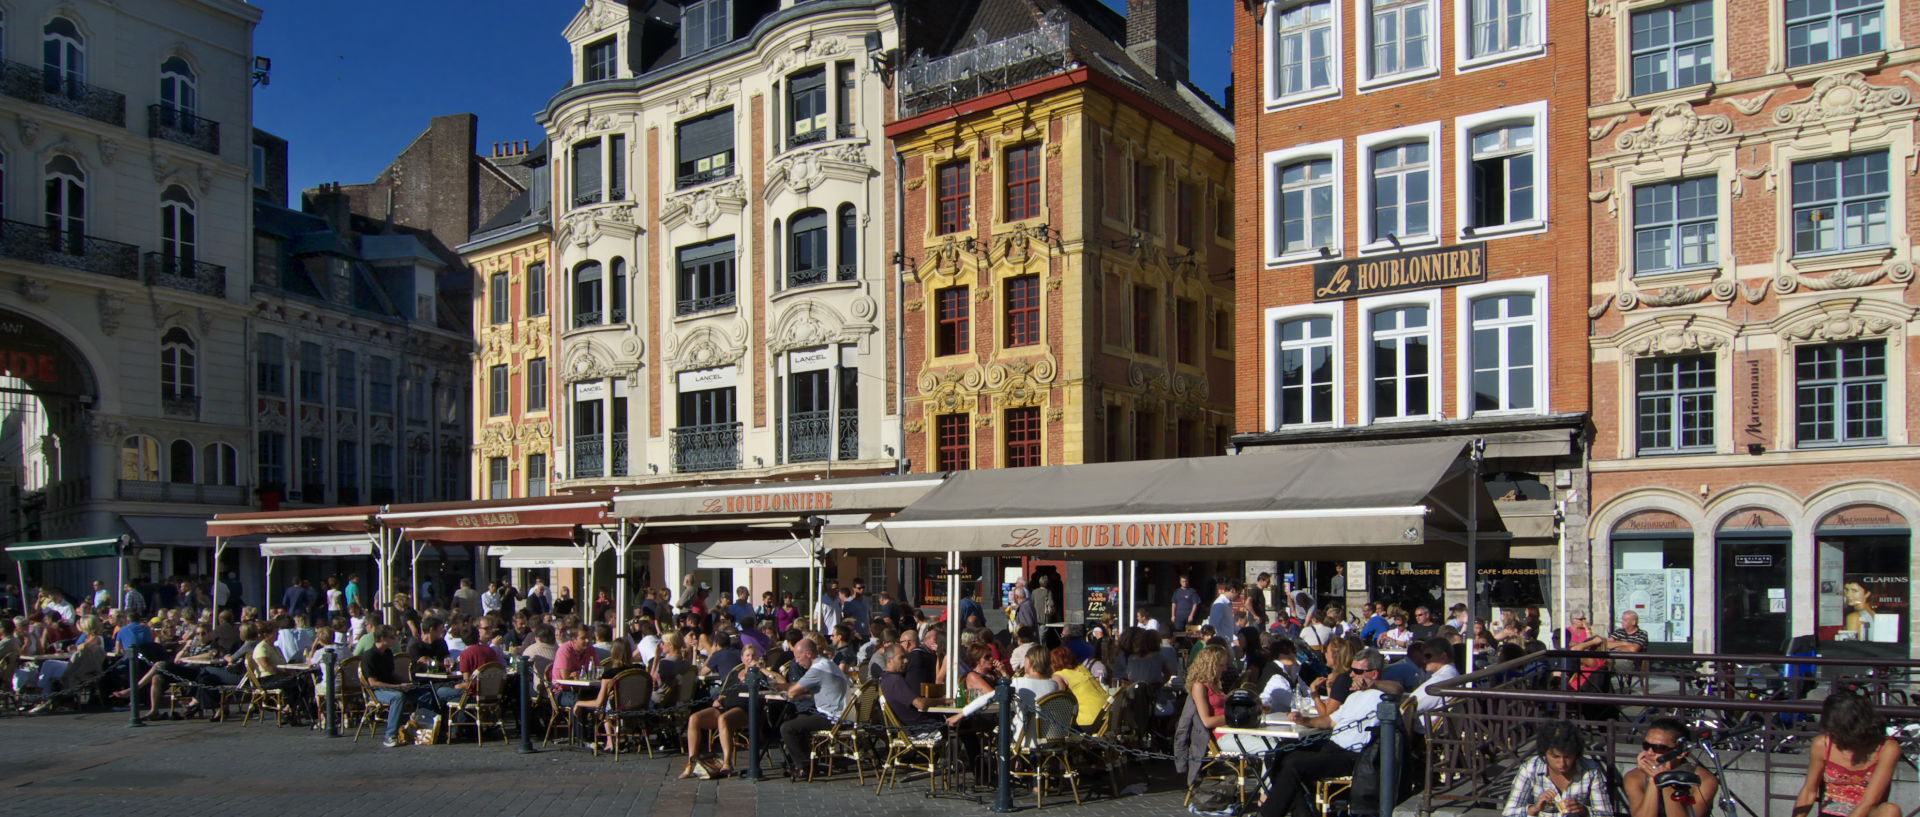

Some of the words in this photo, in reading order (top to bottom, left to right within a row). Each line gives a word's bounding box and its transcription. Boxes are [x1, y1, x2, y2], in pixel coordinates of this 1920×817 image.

[1317, 265, 1351, 297] La
[1357, 248, 1481, 290] HOUBLONNIERE
[794, 354, 826, 363] LANCEL
[695, 374, 722, 382] LANCEL
[1745, 359, 1767, 441] Marionnaud
[697, 498, 723, 514] La
[726, 491, 833, 513] HOUBLONNIERE
[481, 512, 520, 526] HARDI
[1001, 528, 1042, 548] La
[1047, 521, 1230, 548] HOUBLONNIERE
